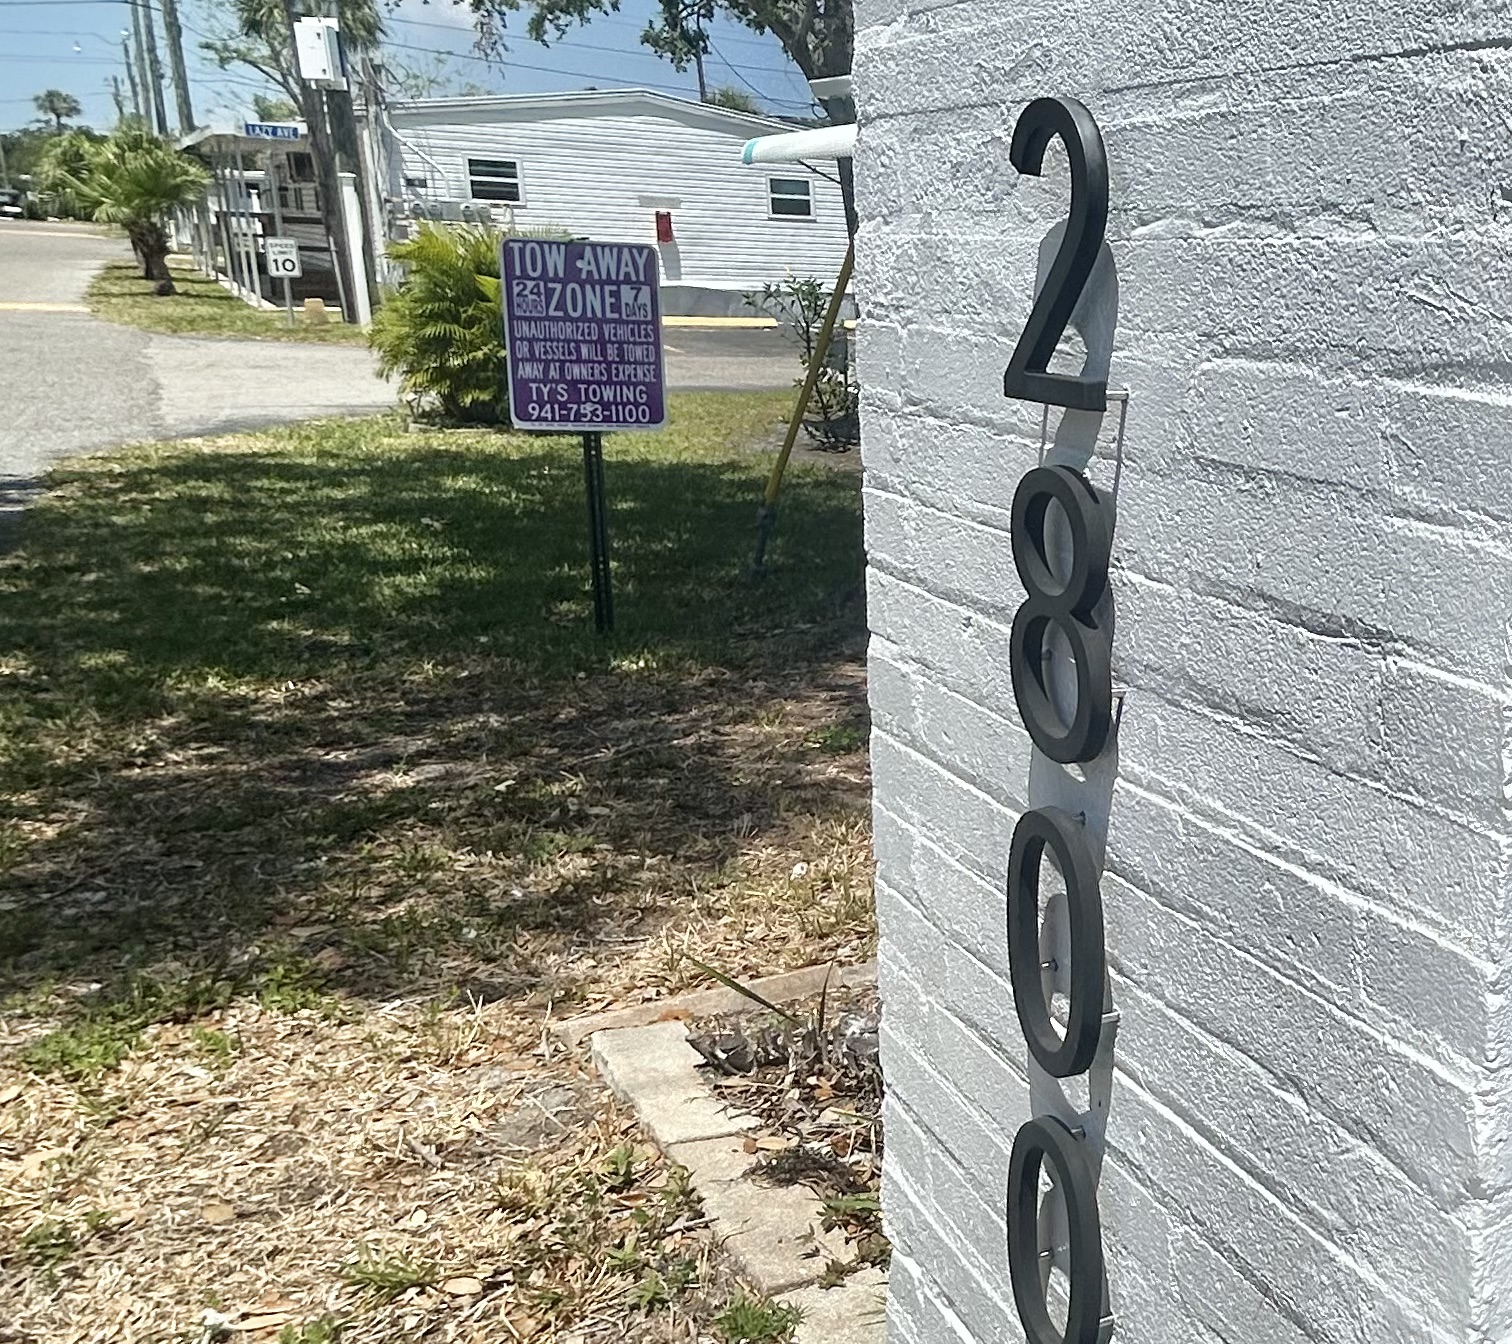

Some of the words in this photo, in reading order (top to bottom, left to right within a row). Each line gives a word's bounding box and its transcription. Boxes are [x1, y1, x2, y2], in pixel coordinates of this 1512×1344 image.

[272, 258, 296, 272] 10
[509, 242, 566, 278] TOW
[580, 245, 649, 281] AWAY
[515, 281, 543, 299] 24
[547, 282, 620, 318] ZONE
[630, 286, 643, 301] 7
[625, 302, 648, 319] DAYS
[513, 320, 599, 341] UNAUTHORIZED
[603, 323, 655, 342] VEHICLES
[515, 340, 530, 359] OR
[533, 342, 577, 360] VESSELS
[580, 343, 604, 361] WILL
[606, 343, 622, 362] BE
[623, 344, 656, 363] TOWED
[517, 361, 544, 380] AWAY
[549, 362, 560, 380] AT
[564, 362, 608, 381] OWNERS
[611, 364, 656, 382] EXPENSE
[529, 383, 569, 401] TY'S
[577, 384, 648, 403] TOWING
[527, 403, 650, 423] 941-753-1100
